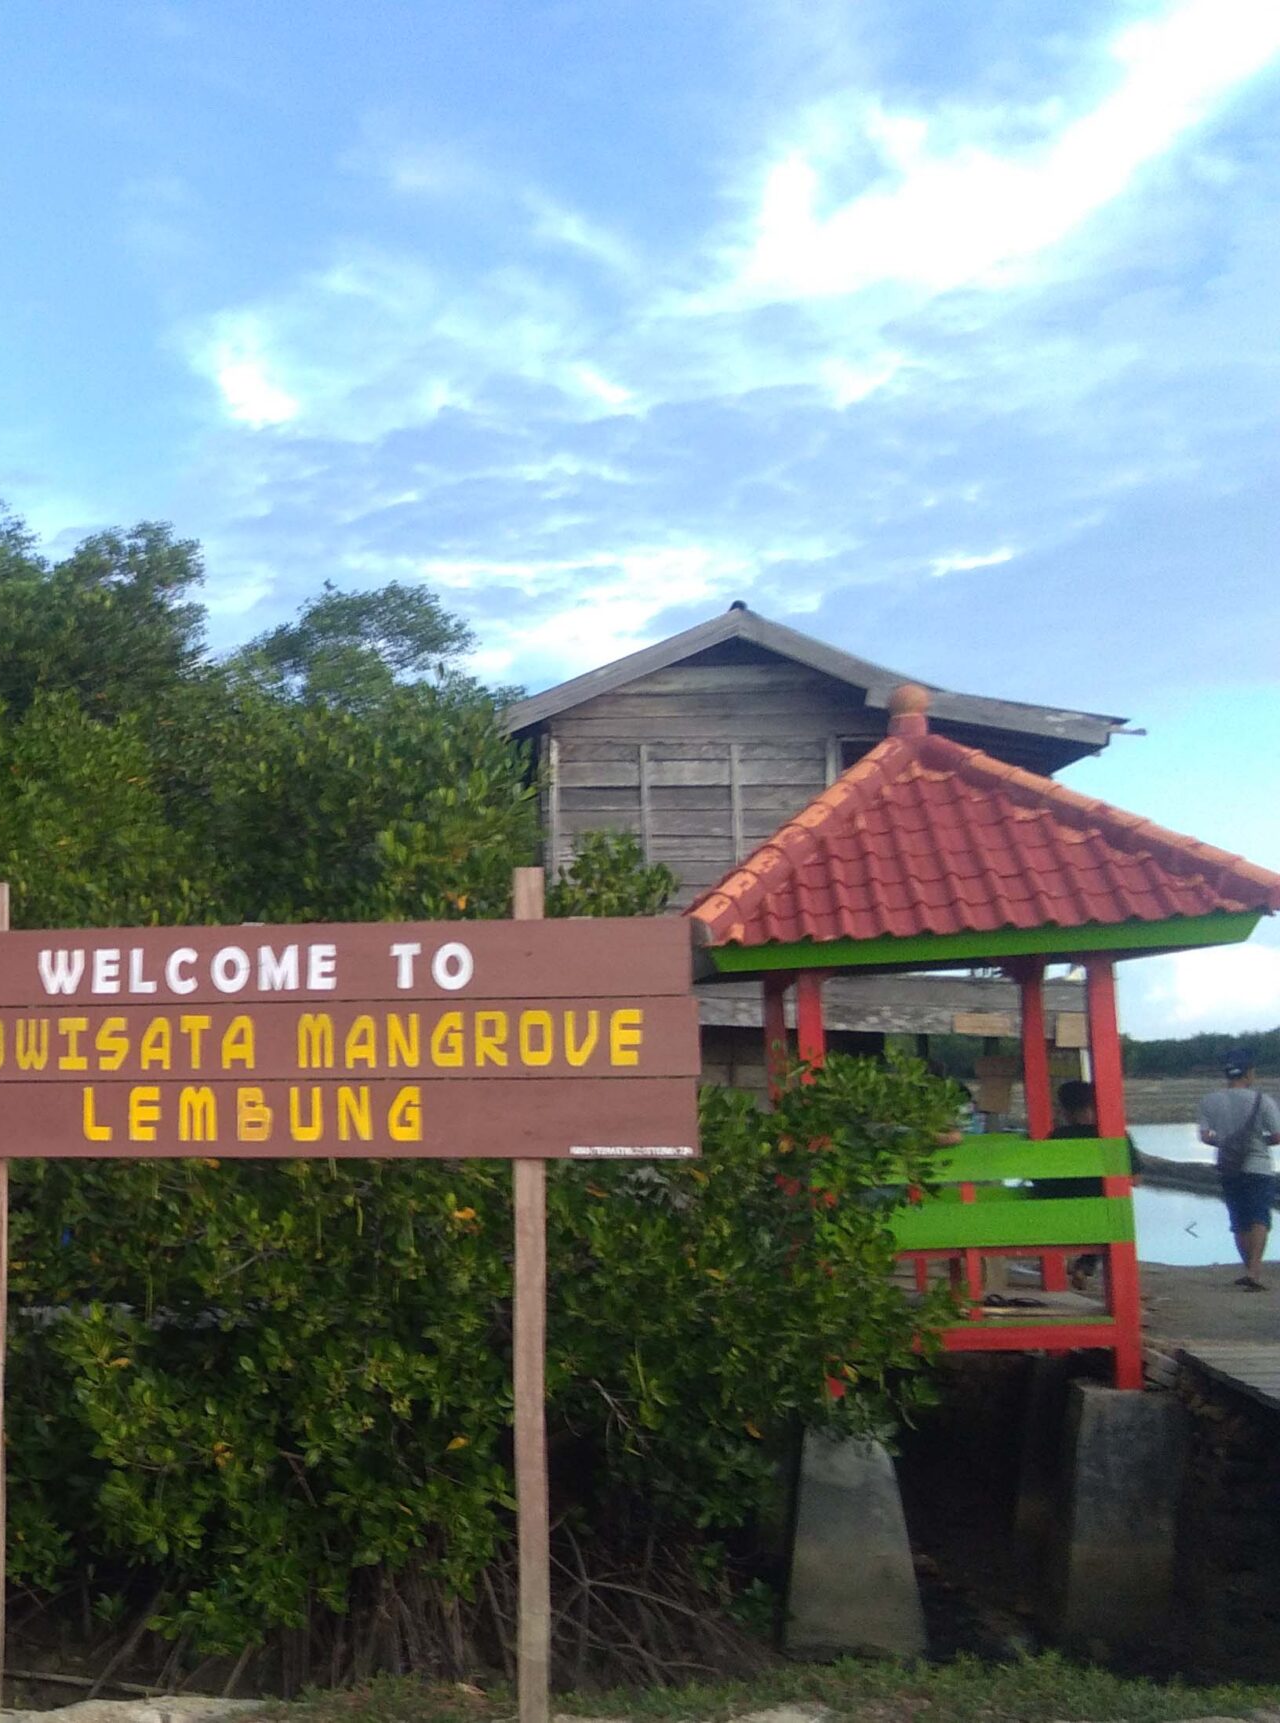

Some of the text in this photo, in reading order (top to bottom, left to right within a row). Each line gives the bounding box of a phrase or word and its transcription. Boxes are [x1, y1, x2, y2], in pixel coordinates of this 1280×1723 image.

[37, 941, 474, 995] WELCOME TO
[296, 1007, 645, 1070] MANGROVE
[81, 1084, 424, 1143] LEMBUNG
